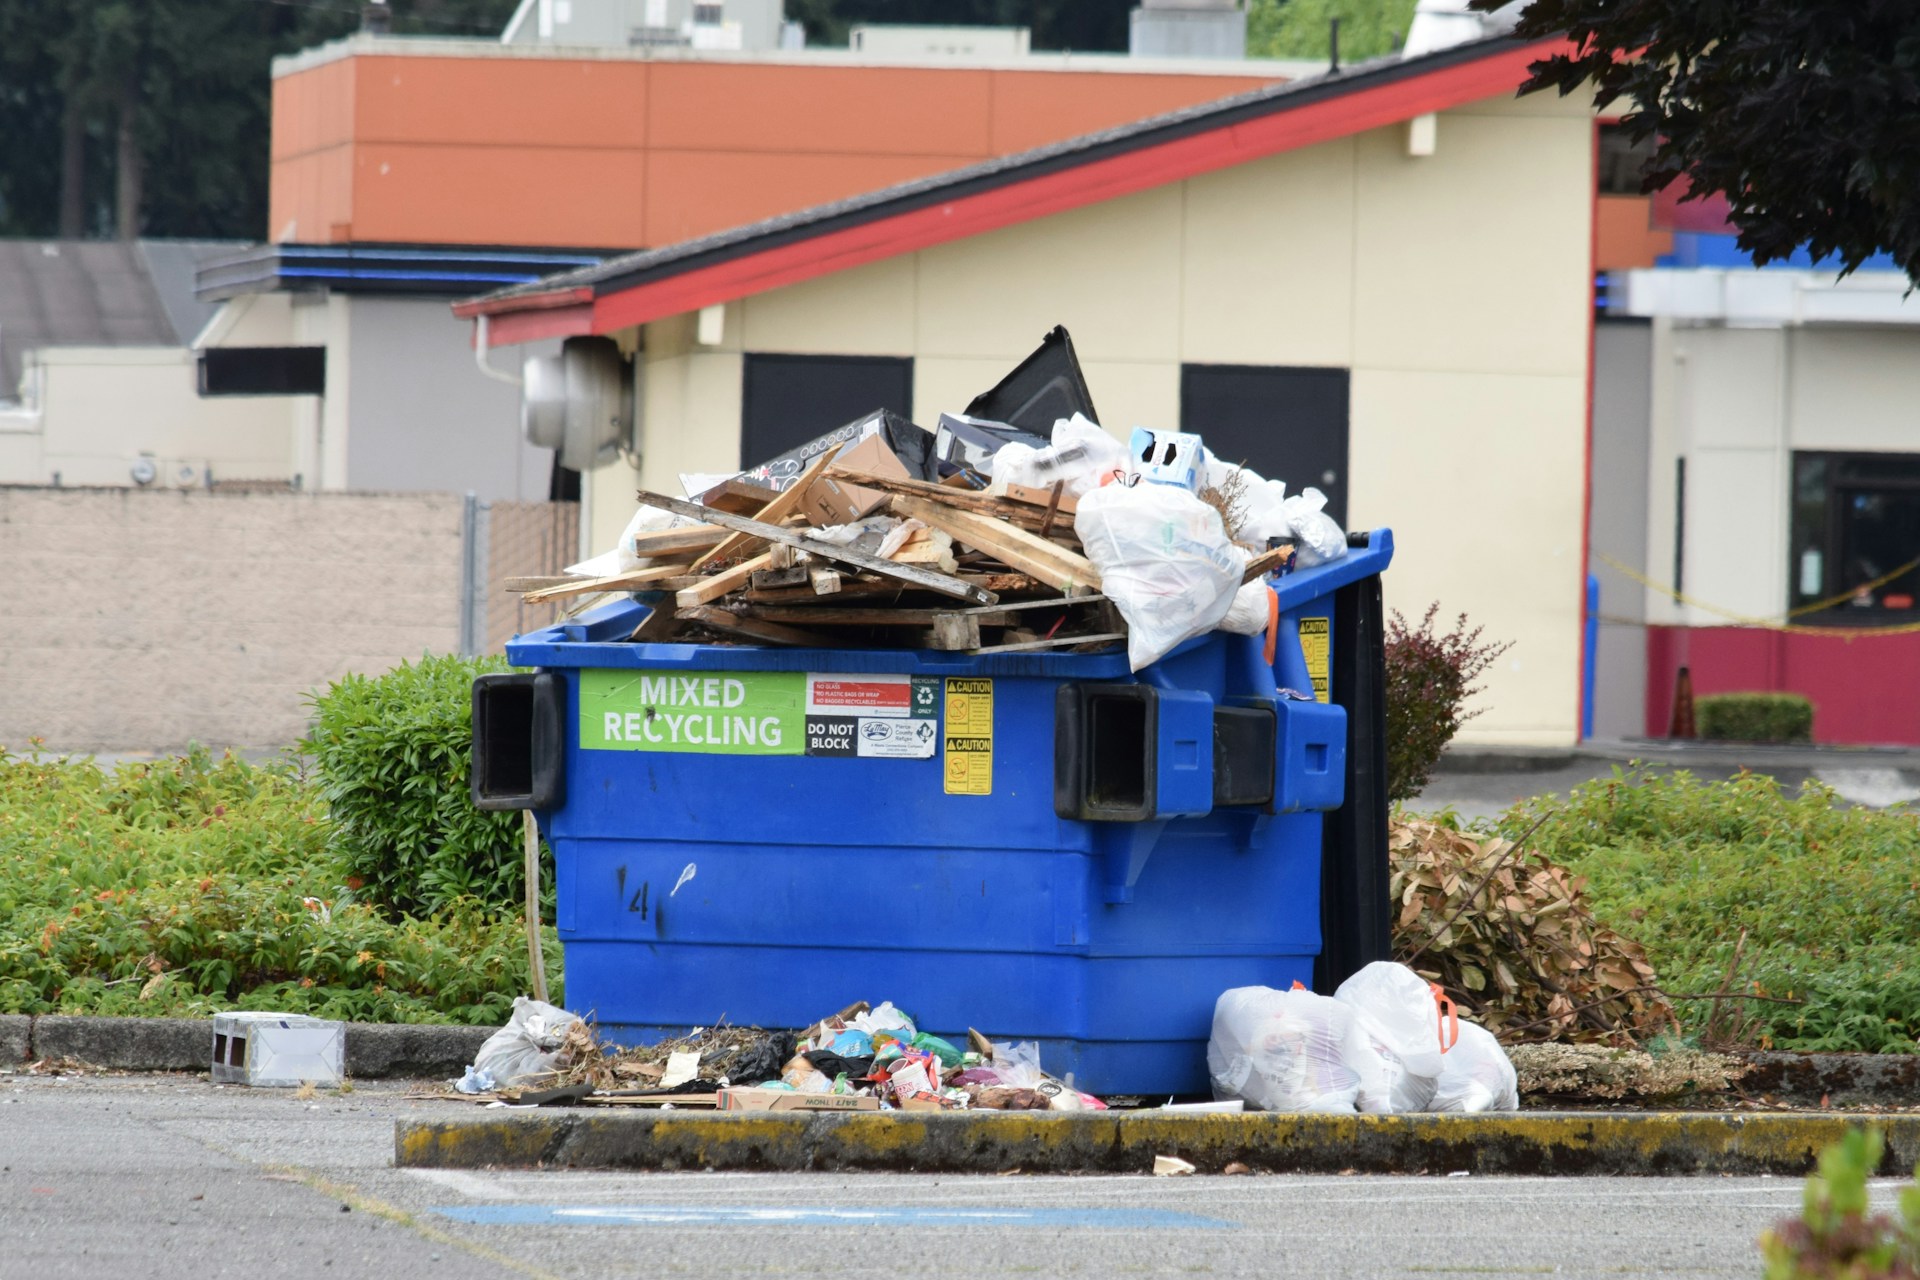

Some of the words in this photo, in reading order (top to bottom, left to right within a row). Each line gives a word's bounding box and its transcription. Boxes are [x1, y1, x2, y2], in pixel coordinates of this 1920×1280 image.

[640, 676, 745, 707] MIXED
[956, 682, 991, 692] CAUTION
[604, 712, 782, 746] RECYCLING
[808, 723, 826, 734] DO
[829, 724, 854, 735] NOT
[811, 737, 850, 749] BLOCK
[956, 740, 990, 750] CAUTION
